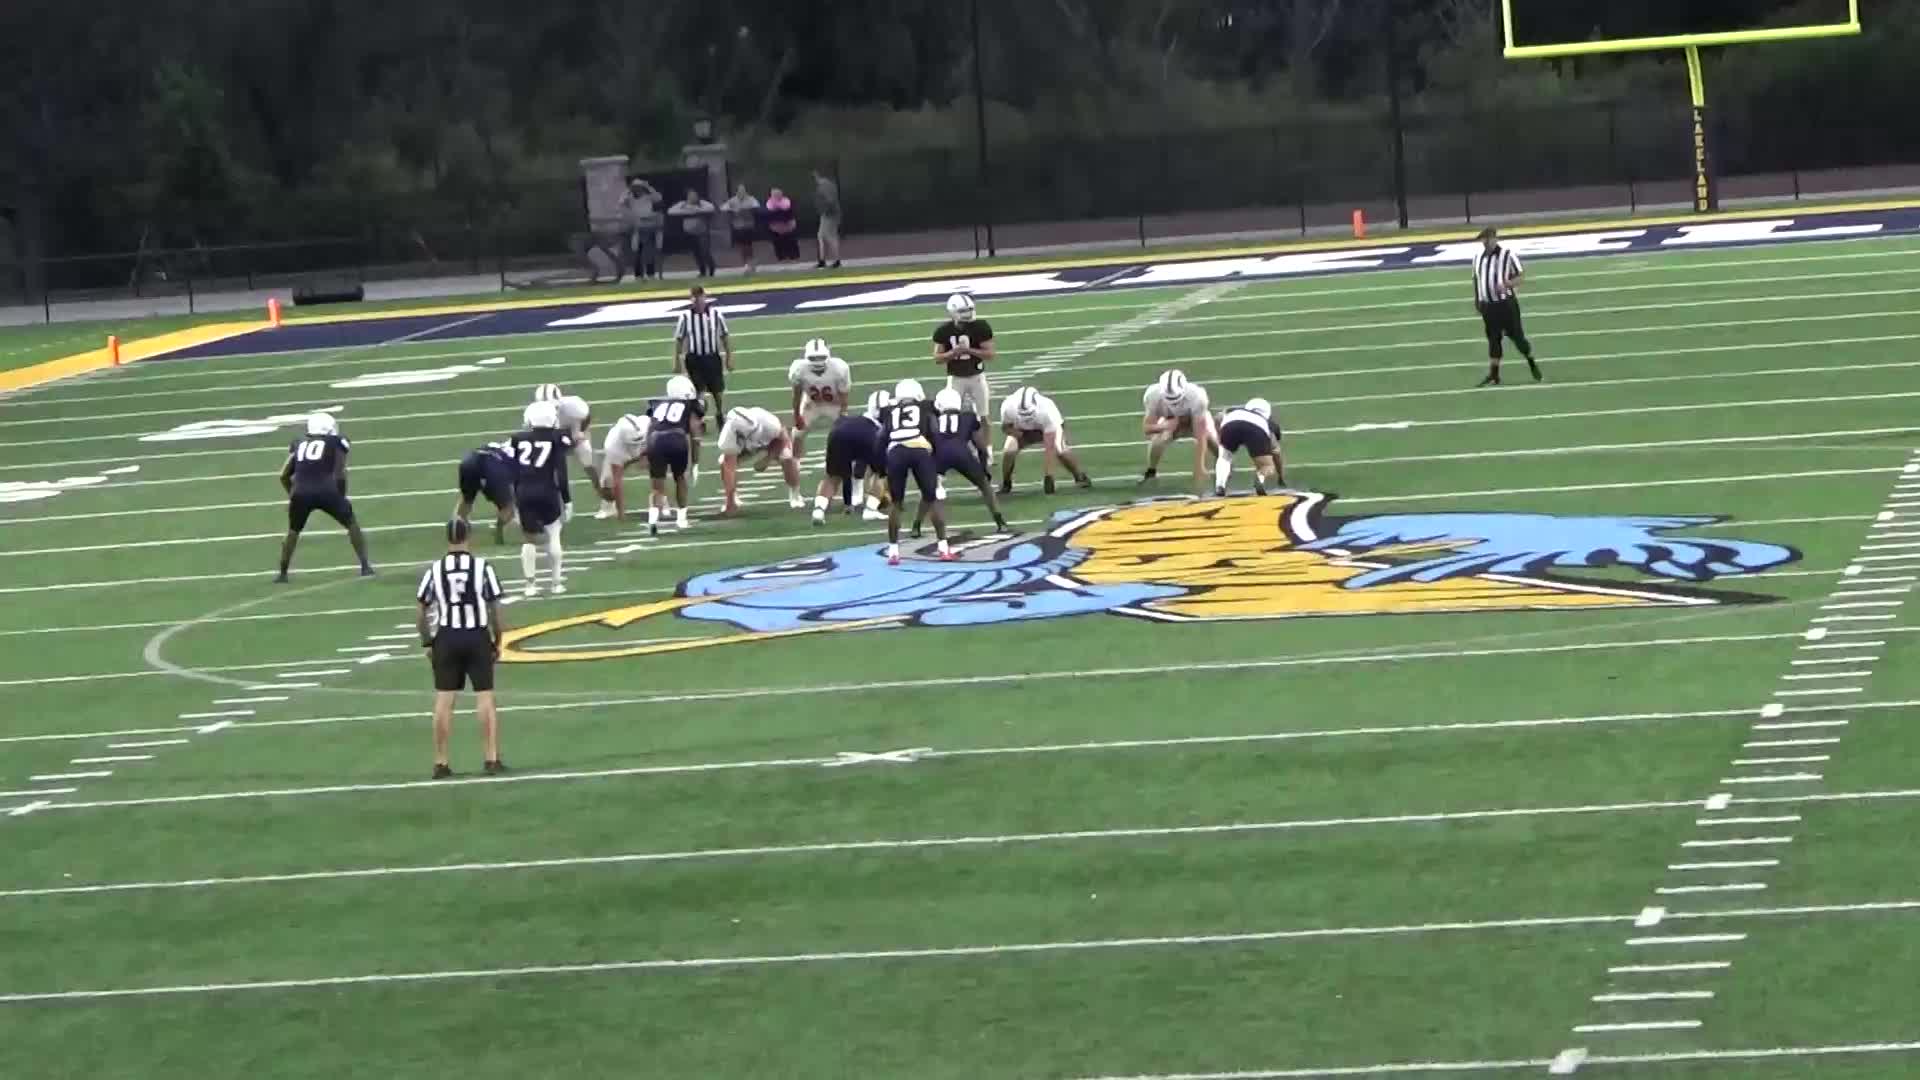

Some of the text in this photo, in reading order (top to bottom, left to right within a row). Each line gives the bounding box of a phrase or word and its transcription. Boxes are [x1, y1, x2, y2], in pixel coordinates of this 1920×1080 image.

[1693, 108, 1709, 212] LAKELAND
[891, 405, 921, 430] 13
[939, 414, 959, 433] 11
[297, 439, 326, 462] 10
[518, 440, 553, 468] 27
[447, 572, 469, 603] F
